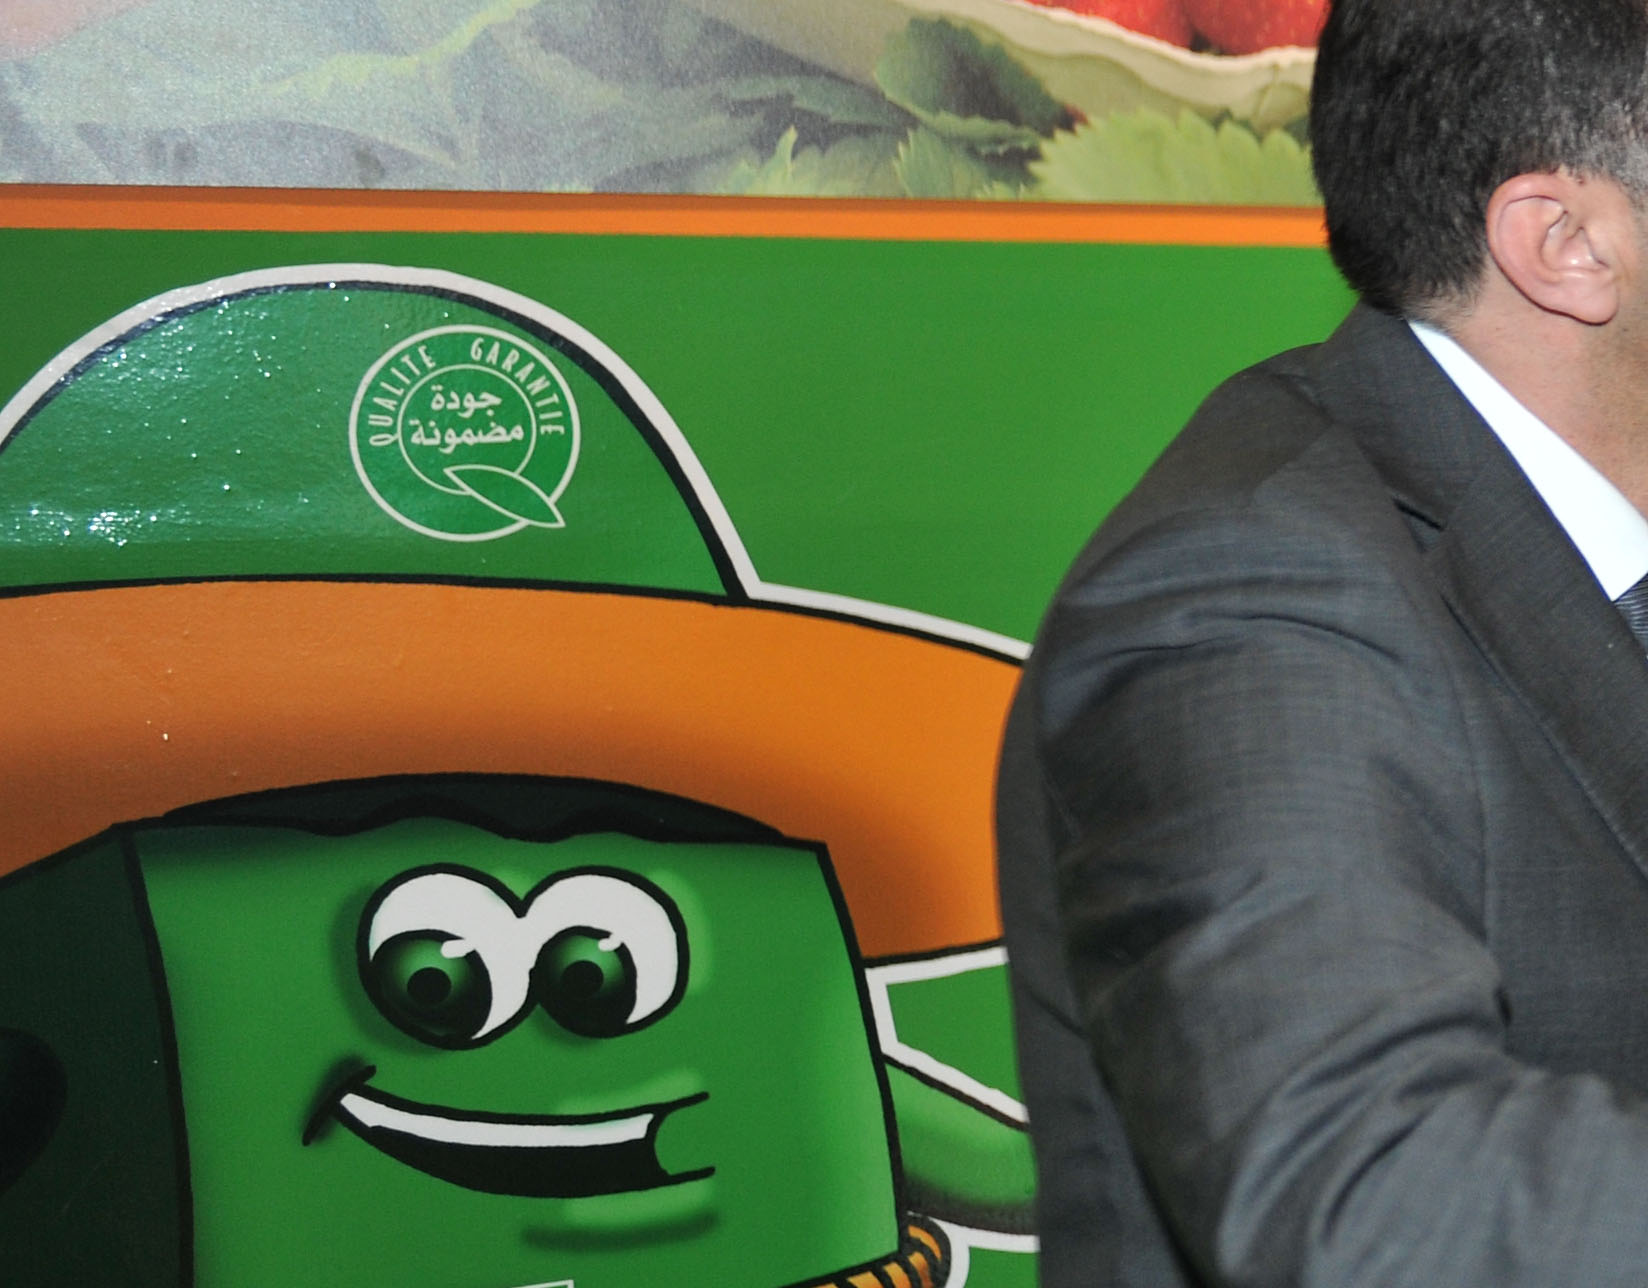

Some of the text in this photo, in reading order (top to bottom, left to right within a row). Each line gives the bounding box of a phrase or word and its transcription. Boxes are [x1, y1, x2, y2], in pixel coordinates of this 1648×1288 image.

[369, 338, 564, 446] QUALITE GARANTIE
[431, 385, 502, 417] جودة
[410, 419, 524, 453] مضمونة
